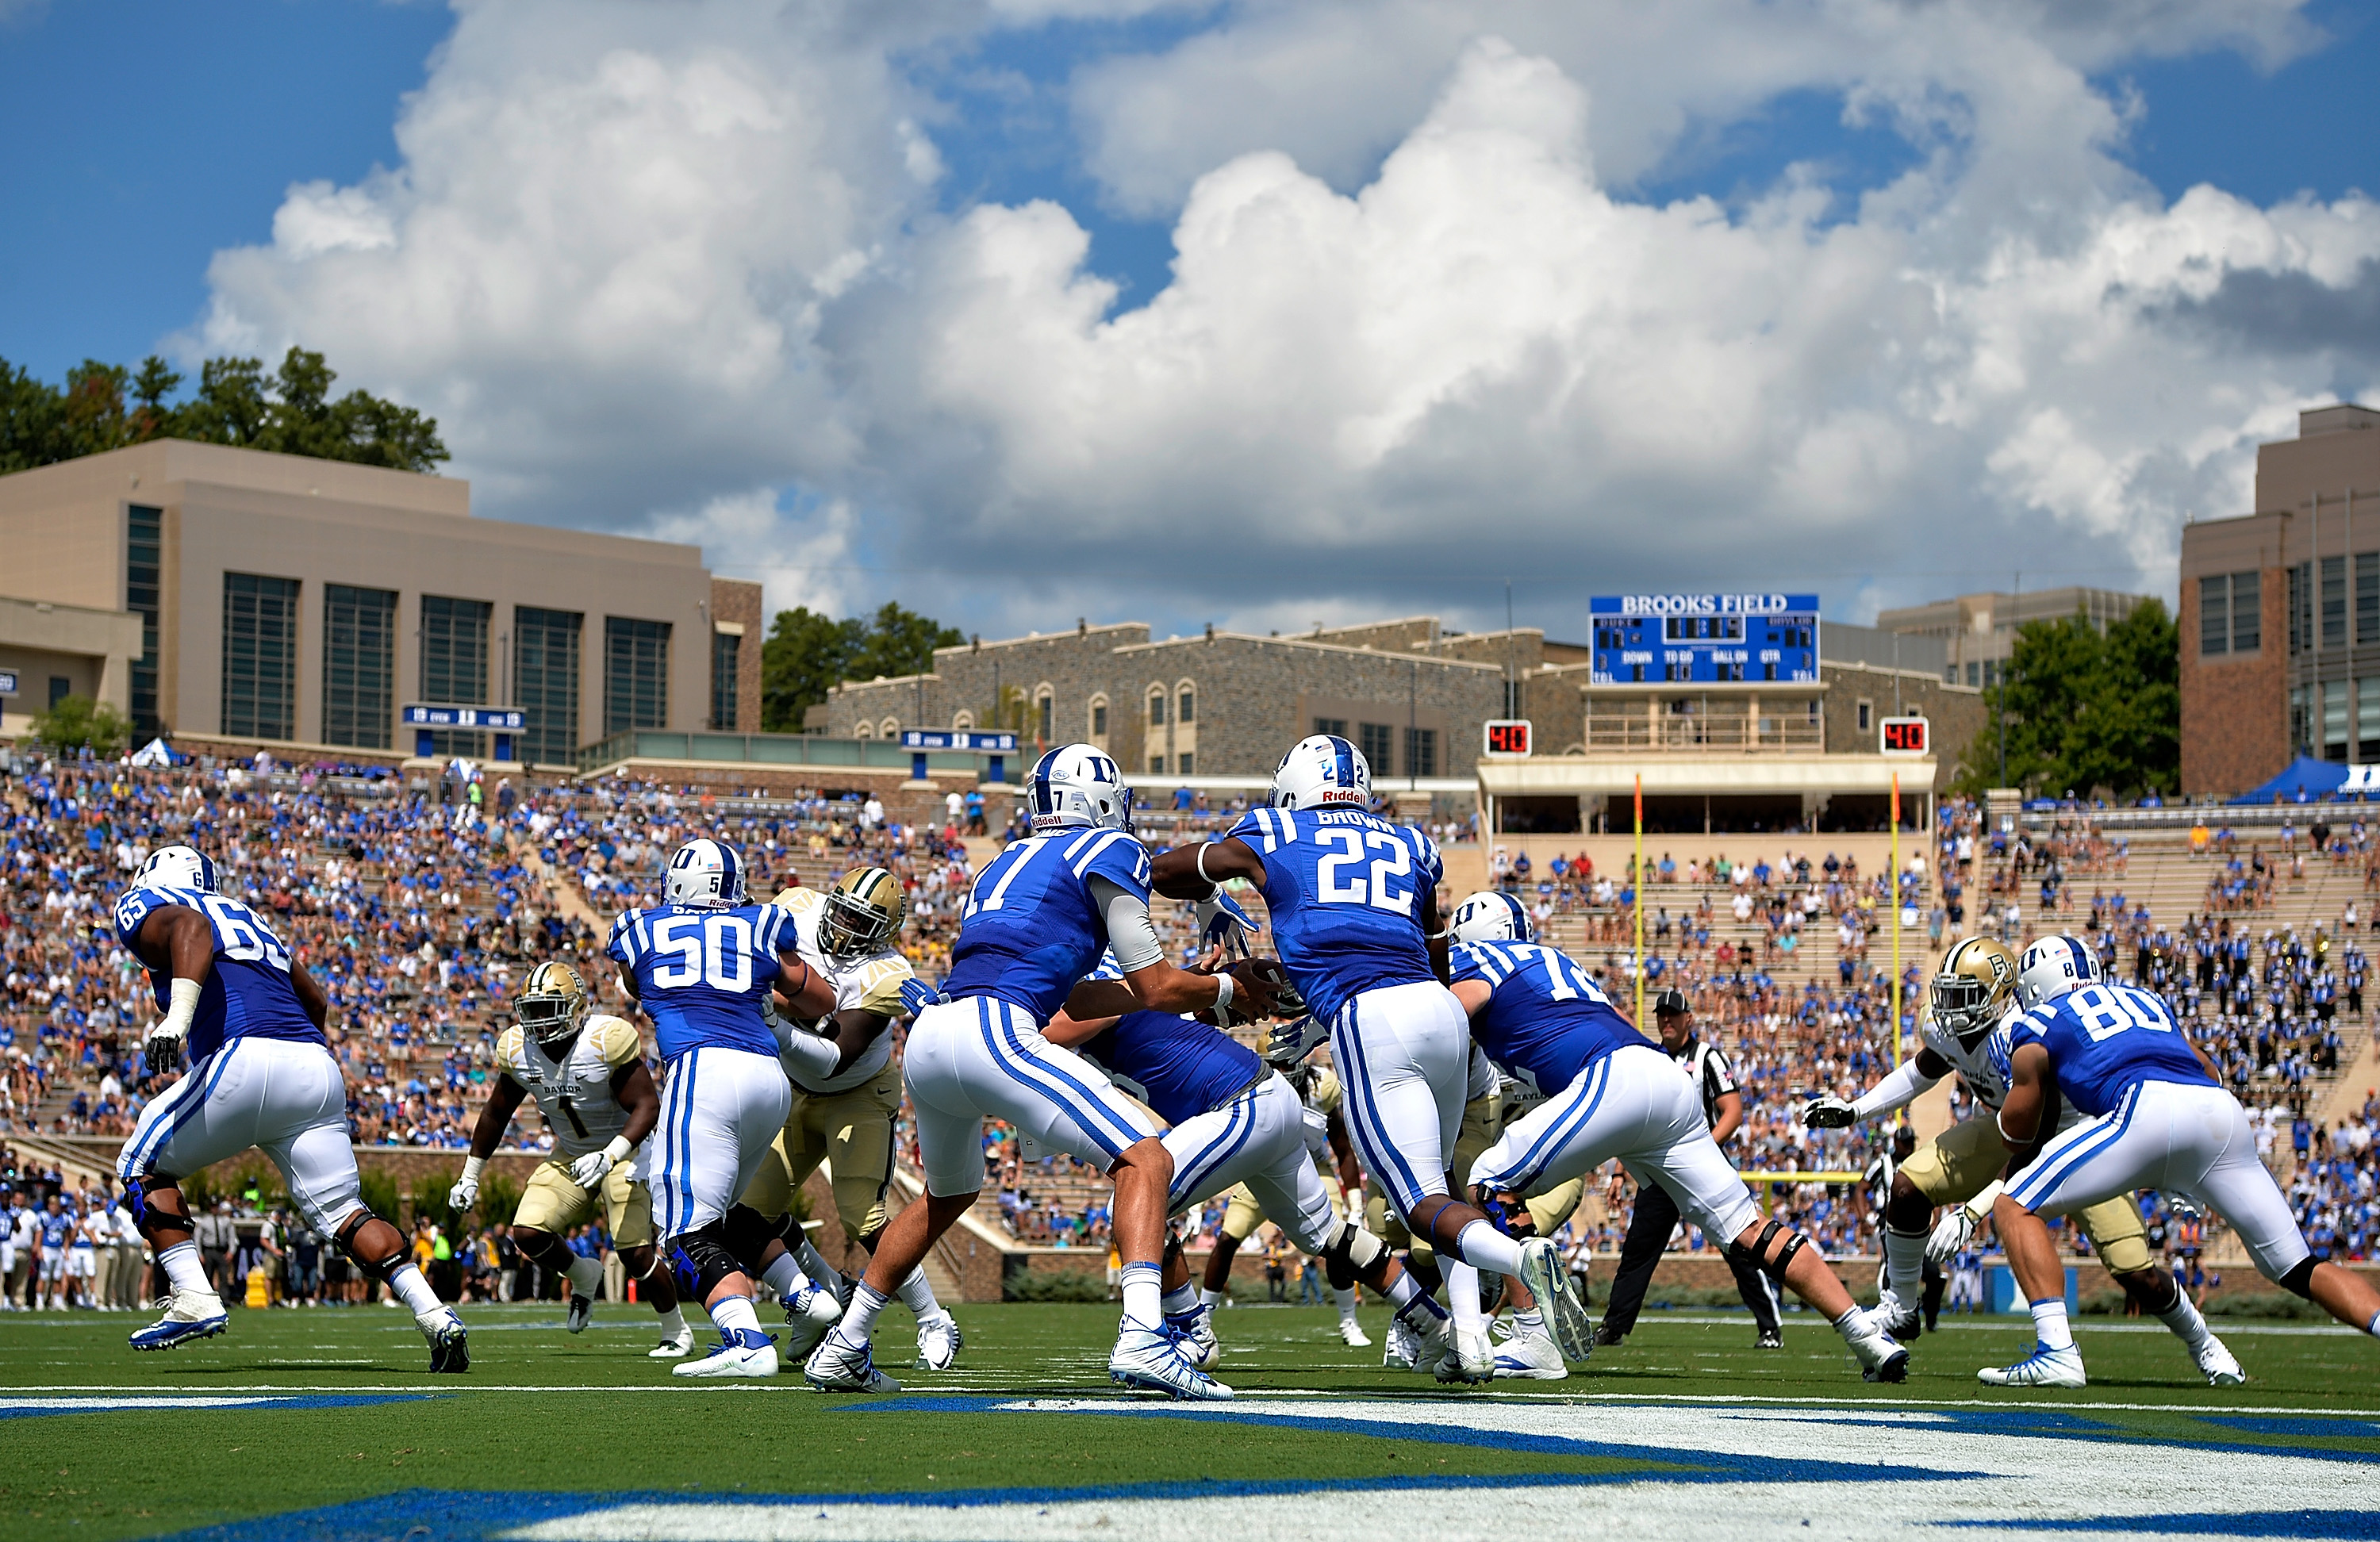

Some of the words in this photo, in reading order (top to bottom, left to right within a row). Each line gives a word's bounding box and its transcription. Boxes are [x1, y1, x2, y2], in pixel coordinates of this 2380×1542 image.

[1623, 595, 1716, 615] BROOKS
[1722, 594, 1787, 615] FIELD
[1621, 650, 1653, 665] DOWN
[1664, 650, 1678, 664] TO
[1710, 649, 1733, 664] BALL
[1733, 649, 1749, 664] ON
[1490, 725, 1526, 752] 40
[1885, 723, 1924, 750] 40
[1322, 761, 1334, 781] 2
[1356, 765, 1364, 784] 2
[1031, 794, 1038, 814] 1
[1053, 791, 1063, 811] 7
[1322, 790, 1366, 806] Riddell
[1031, 815, 1062, 827] Riddell
[1316, 811, 1396, 834] BROWN
[193, 872, 202, 887] 6
[963, 838, 1050, 921] 17
[1314, 827, 1414, 917] 22
[709, 876, 720, 893] 5
[735, 880, 742, 898] 0
[119, 892, 148, 931] 65
[1504, 923, 1512, 940] 7
[652, 915, 753, 993] 50
[2063, 962, 2075, 977] 8
[2090, 961, 2098, 976] 0
[2067, 987, 2174, 1043] 80
[544, 1084, 582, 1094] BAYLOR
[558, 1095, 589, 1140] 1
